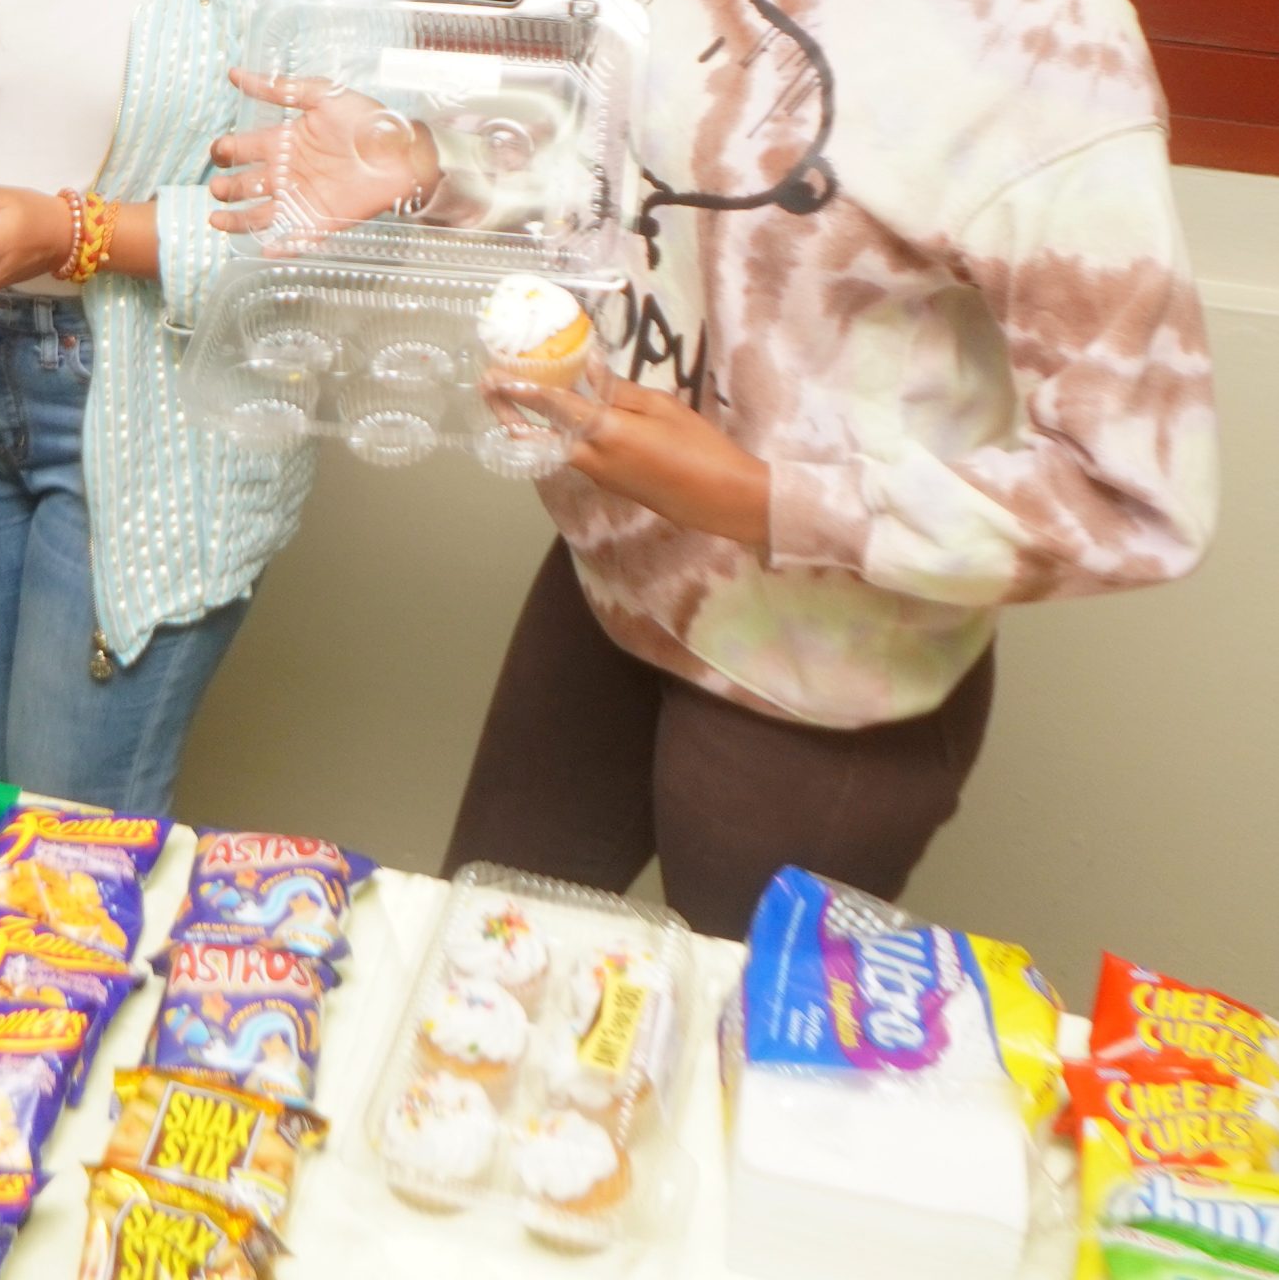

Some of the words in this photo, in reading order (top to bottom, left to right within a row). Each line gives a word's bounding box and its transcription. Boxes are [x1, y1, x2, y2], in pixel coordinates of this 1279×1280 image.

[207, 833, 340, 867] ASTROS
[171, 944, 311, 987] ASTROS
[1135, 1017, 1256, 1078] CURLS
[164, 1090, 257, 1148] SNAX
[157, 1130, 238, 1184] STIX
[123, 1203, 217, 1267] SNAX
